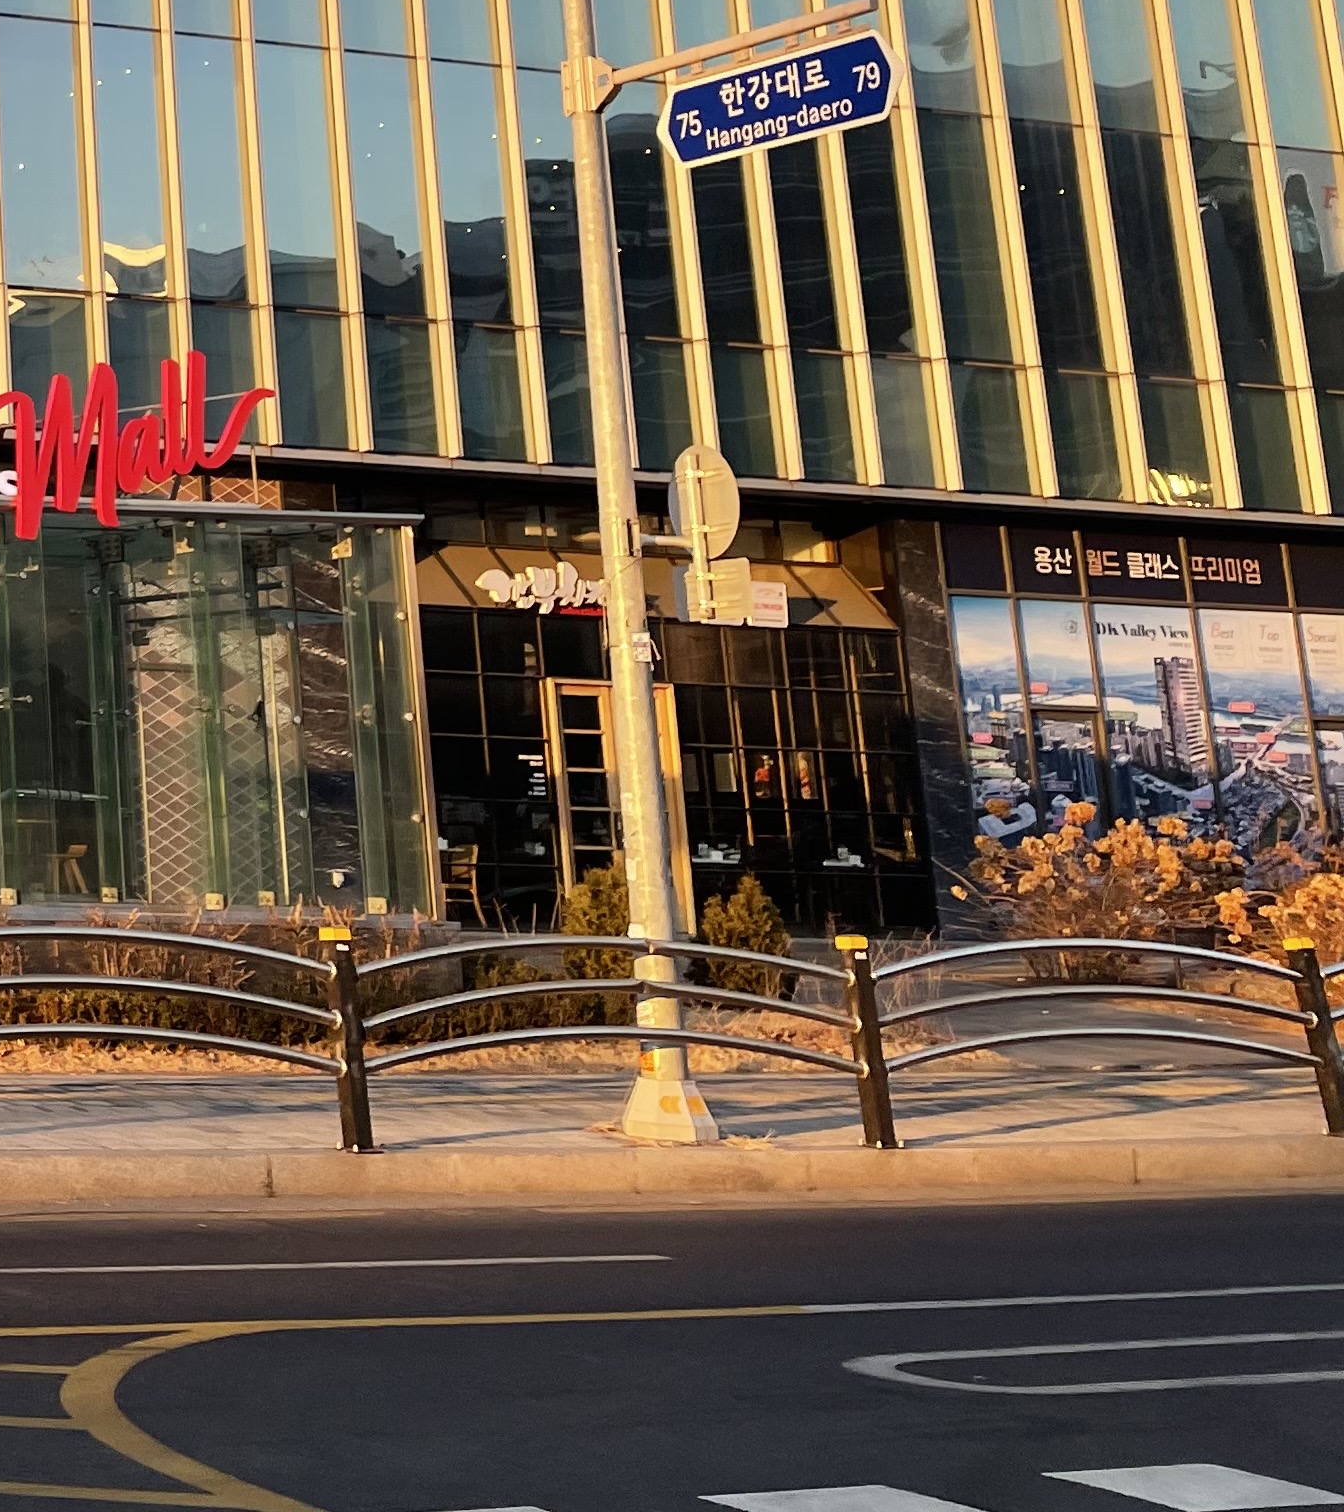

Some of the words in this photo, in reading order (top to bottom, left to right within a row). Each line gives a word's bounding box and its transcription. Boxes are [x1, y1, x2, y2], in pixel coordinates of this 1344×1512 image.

[719, 58, 830, 118] 한강대로
[852, 61, 881, 93] 79
[676, 109, 702, 140] 75
[705, 98, 853, 151] Hangang-daero
[1033, 546, 1072, 575] 용산
[1086, 549, 1122, 576] 월드
[1126, 552, 1180, 580] 클래스
[1190, 556, 1263, 585] 프리미엄
[1095, 621, 1119, 636] DK
[1121, 623, 1157, 641] Valley
[1160, 625, 1190, 639] View
[1211, 622, 1234, 639] Best
